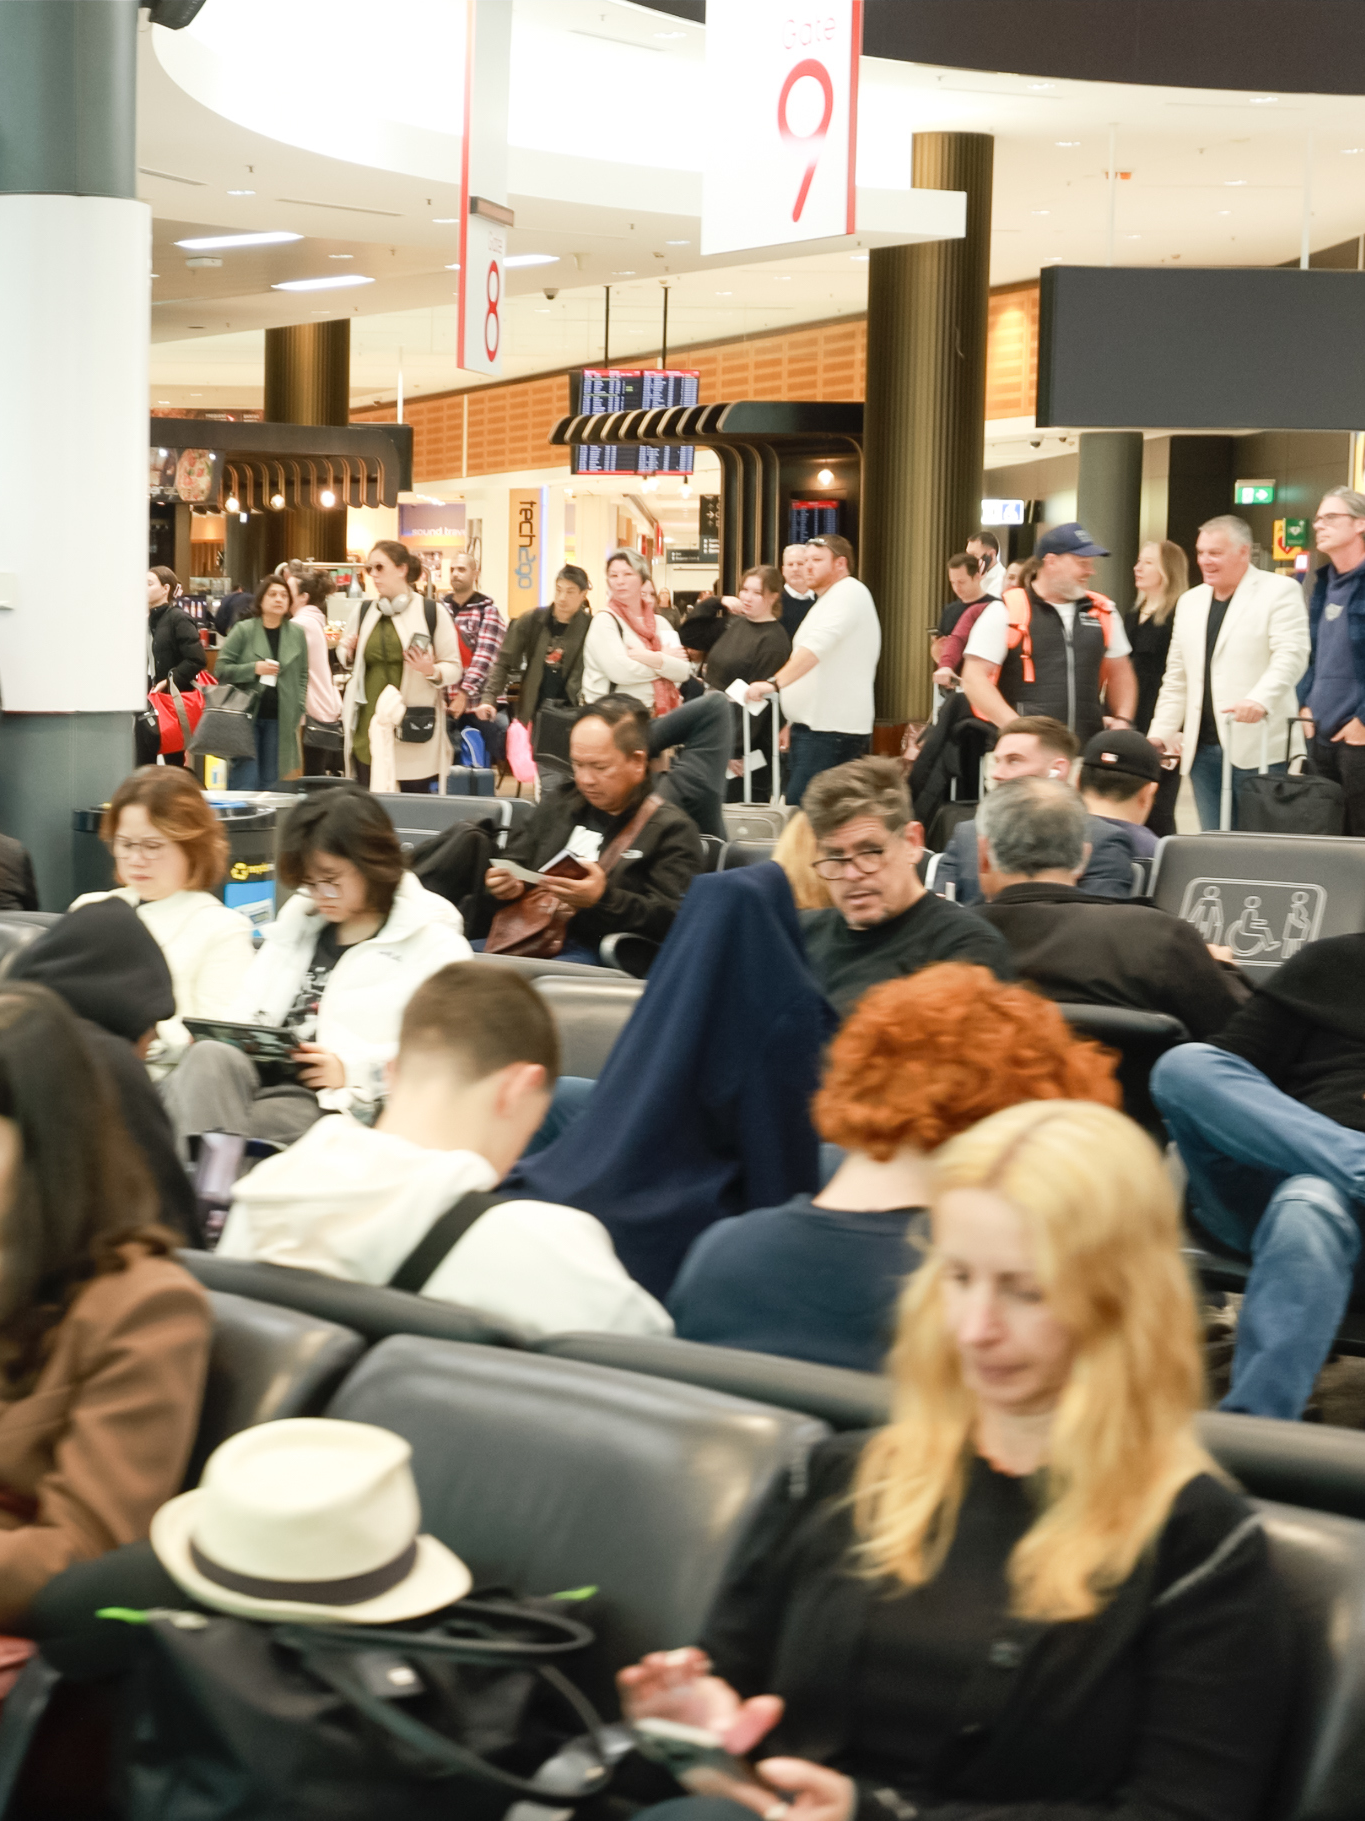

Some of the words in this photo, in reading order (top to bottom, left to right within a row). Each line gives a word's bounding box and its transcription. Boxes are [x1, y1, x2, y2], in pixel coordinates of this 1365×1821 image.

[783, 16, 836, 50] Gate
[777, 58, 834, 223] 9
[484, 259, 501, 362] 8
[412, 526, 443, 536] sound
[515, 500, 538, 589] tech2go
